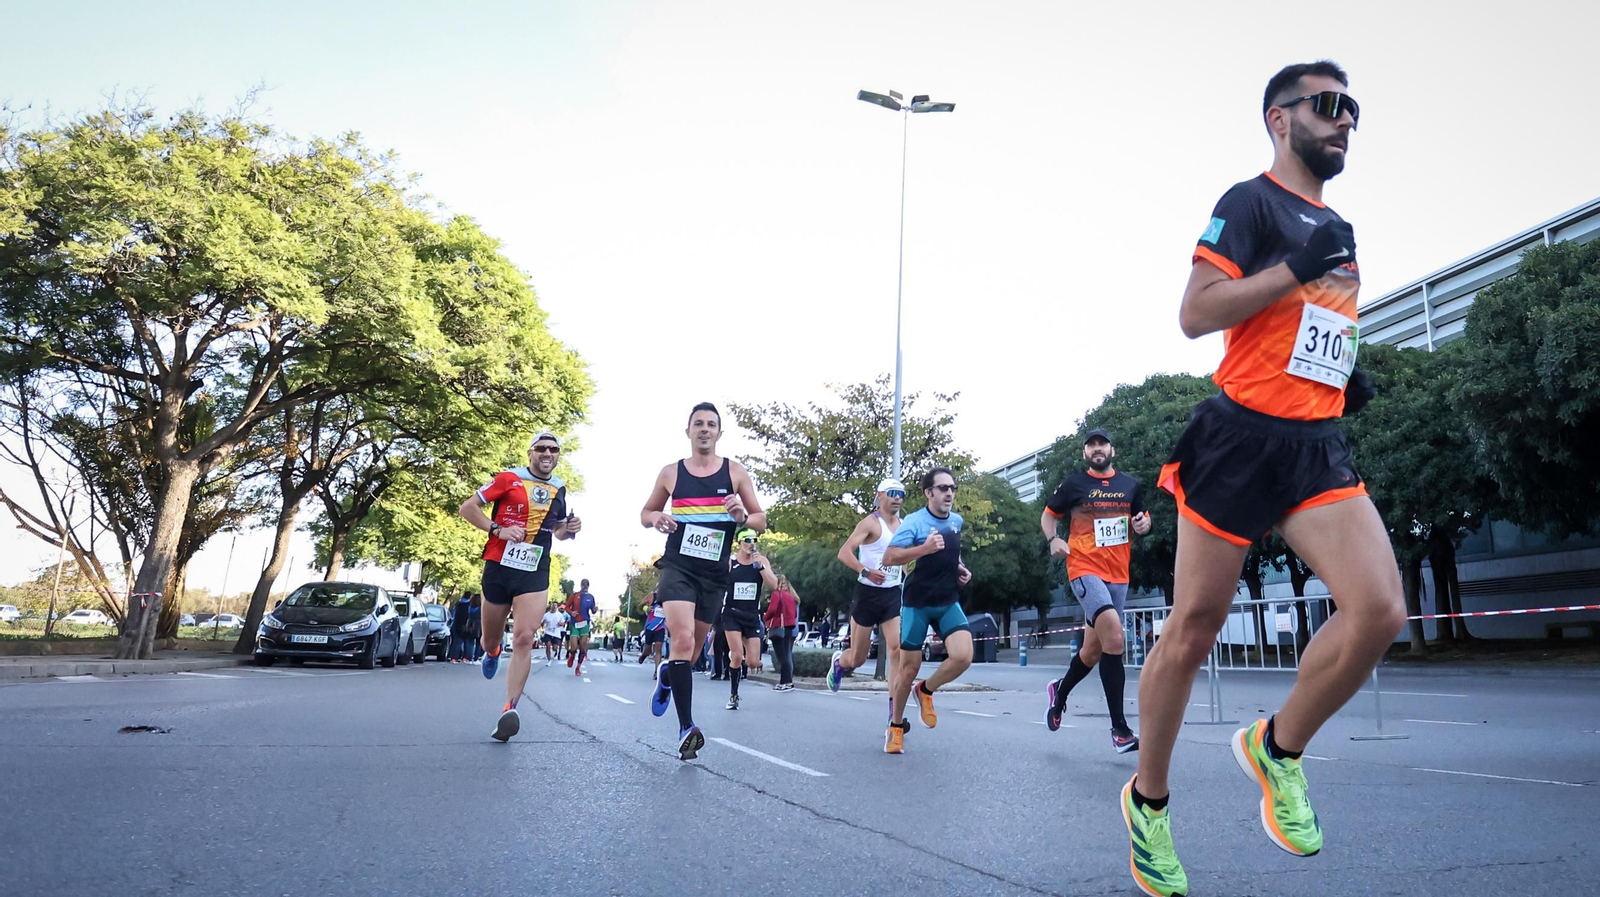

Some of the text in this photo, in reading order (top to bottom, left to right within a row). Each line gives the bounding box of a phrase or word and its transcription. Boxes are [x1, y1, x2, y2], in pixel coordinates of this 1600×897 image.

[1305, 326, 1342, 361] 310
[1088, 489, 1125, 498] Picoco
[1100, 525, 1117, 537] 181
[687, 533, 709, 549] 488
[508, 547, 528, 561] 413
